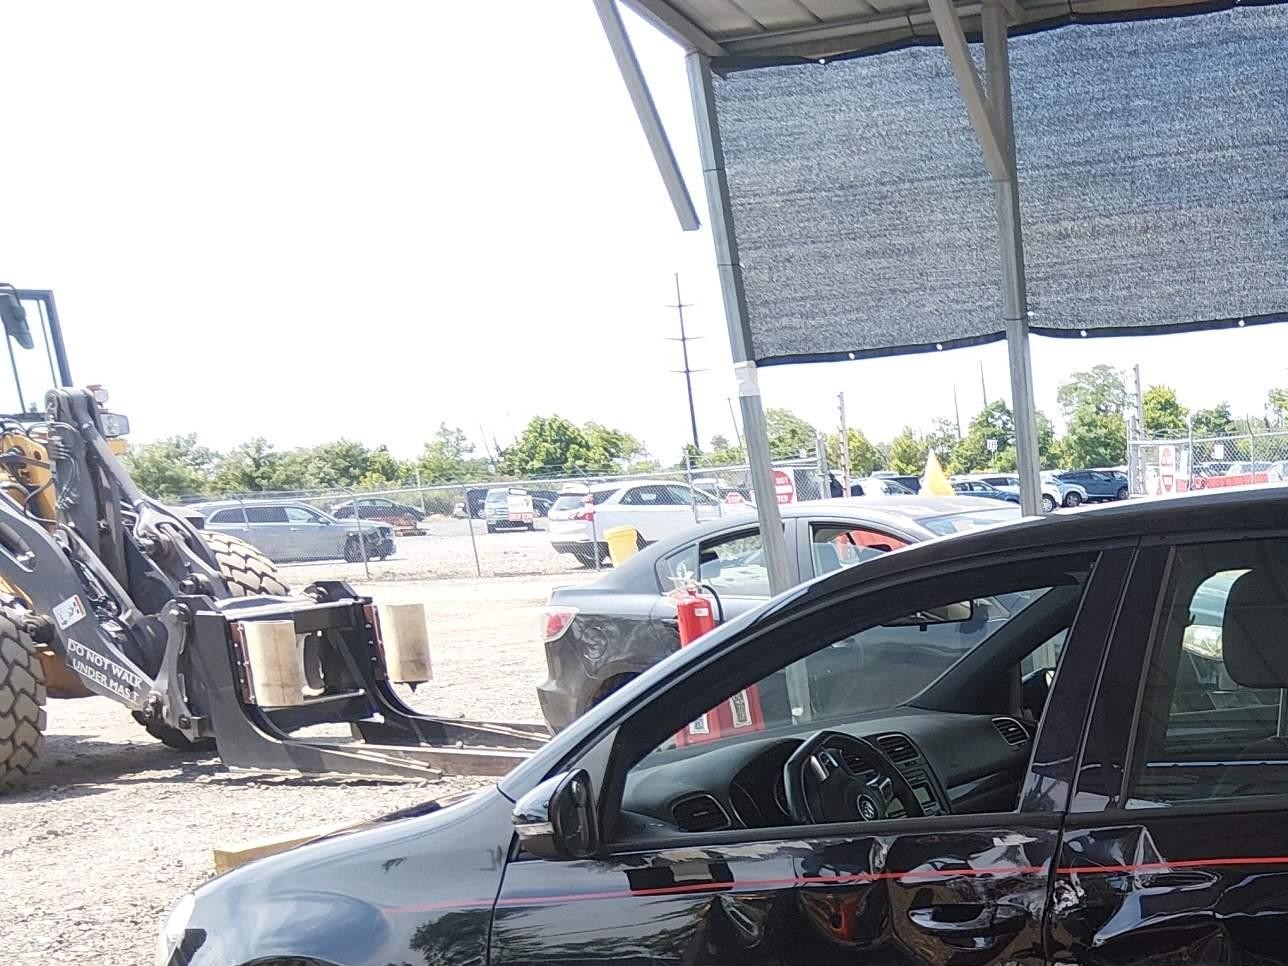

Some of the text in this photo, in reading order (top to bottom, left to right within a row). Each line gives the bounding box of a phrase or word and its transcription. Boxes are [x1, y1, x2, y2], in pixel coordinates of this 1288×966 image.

[68, 641, 143, 690] DO NOT WALK
[72, 658, 140, 702] UNDER MAST
